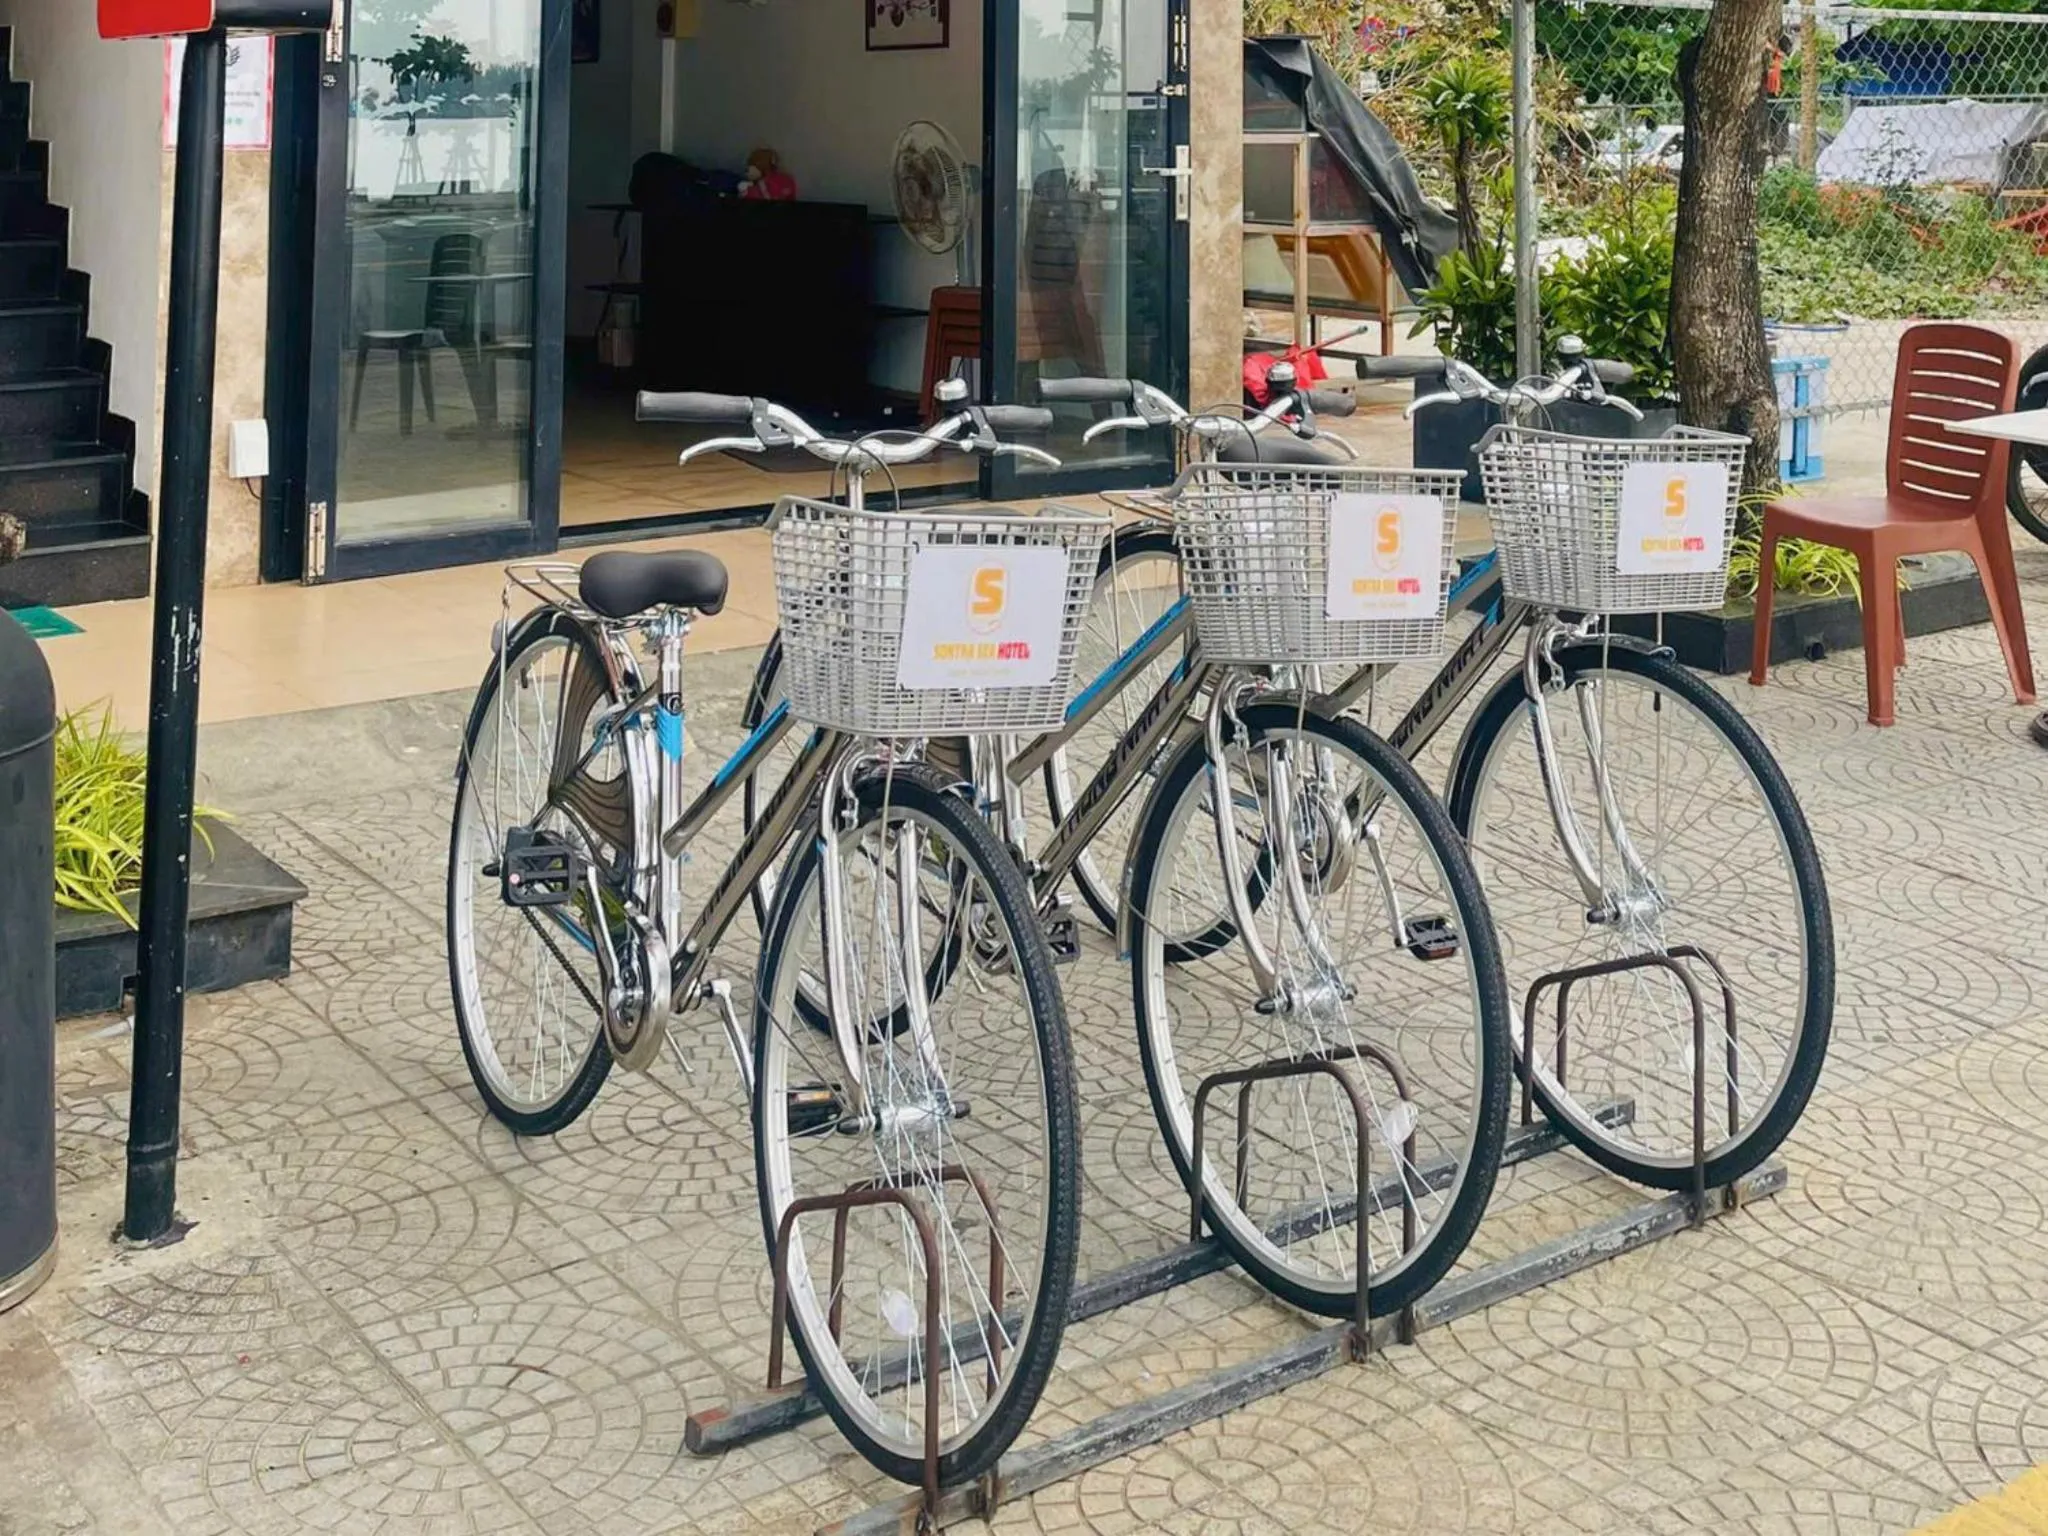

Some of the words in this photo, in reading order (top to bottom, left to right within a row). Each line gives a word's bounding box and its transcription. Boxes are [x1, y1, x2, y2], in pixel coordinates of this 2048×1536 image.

[1664, 479, 1686, 517] S
[1376, 511, 1399, 554] S
[971, 567, 1005, 615] S
[998, 641, 1030, 661] HOTEL
